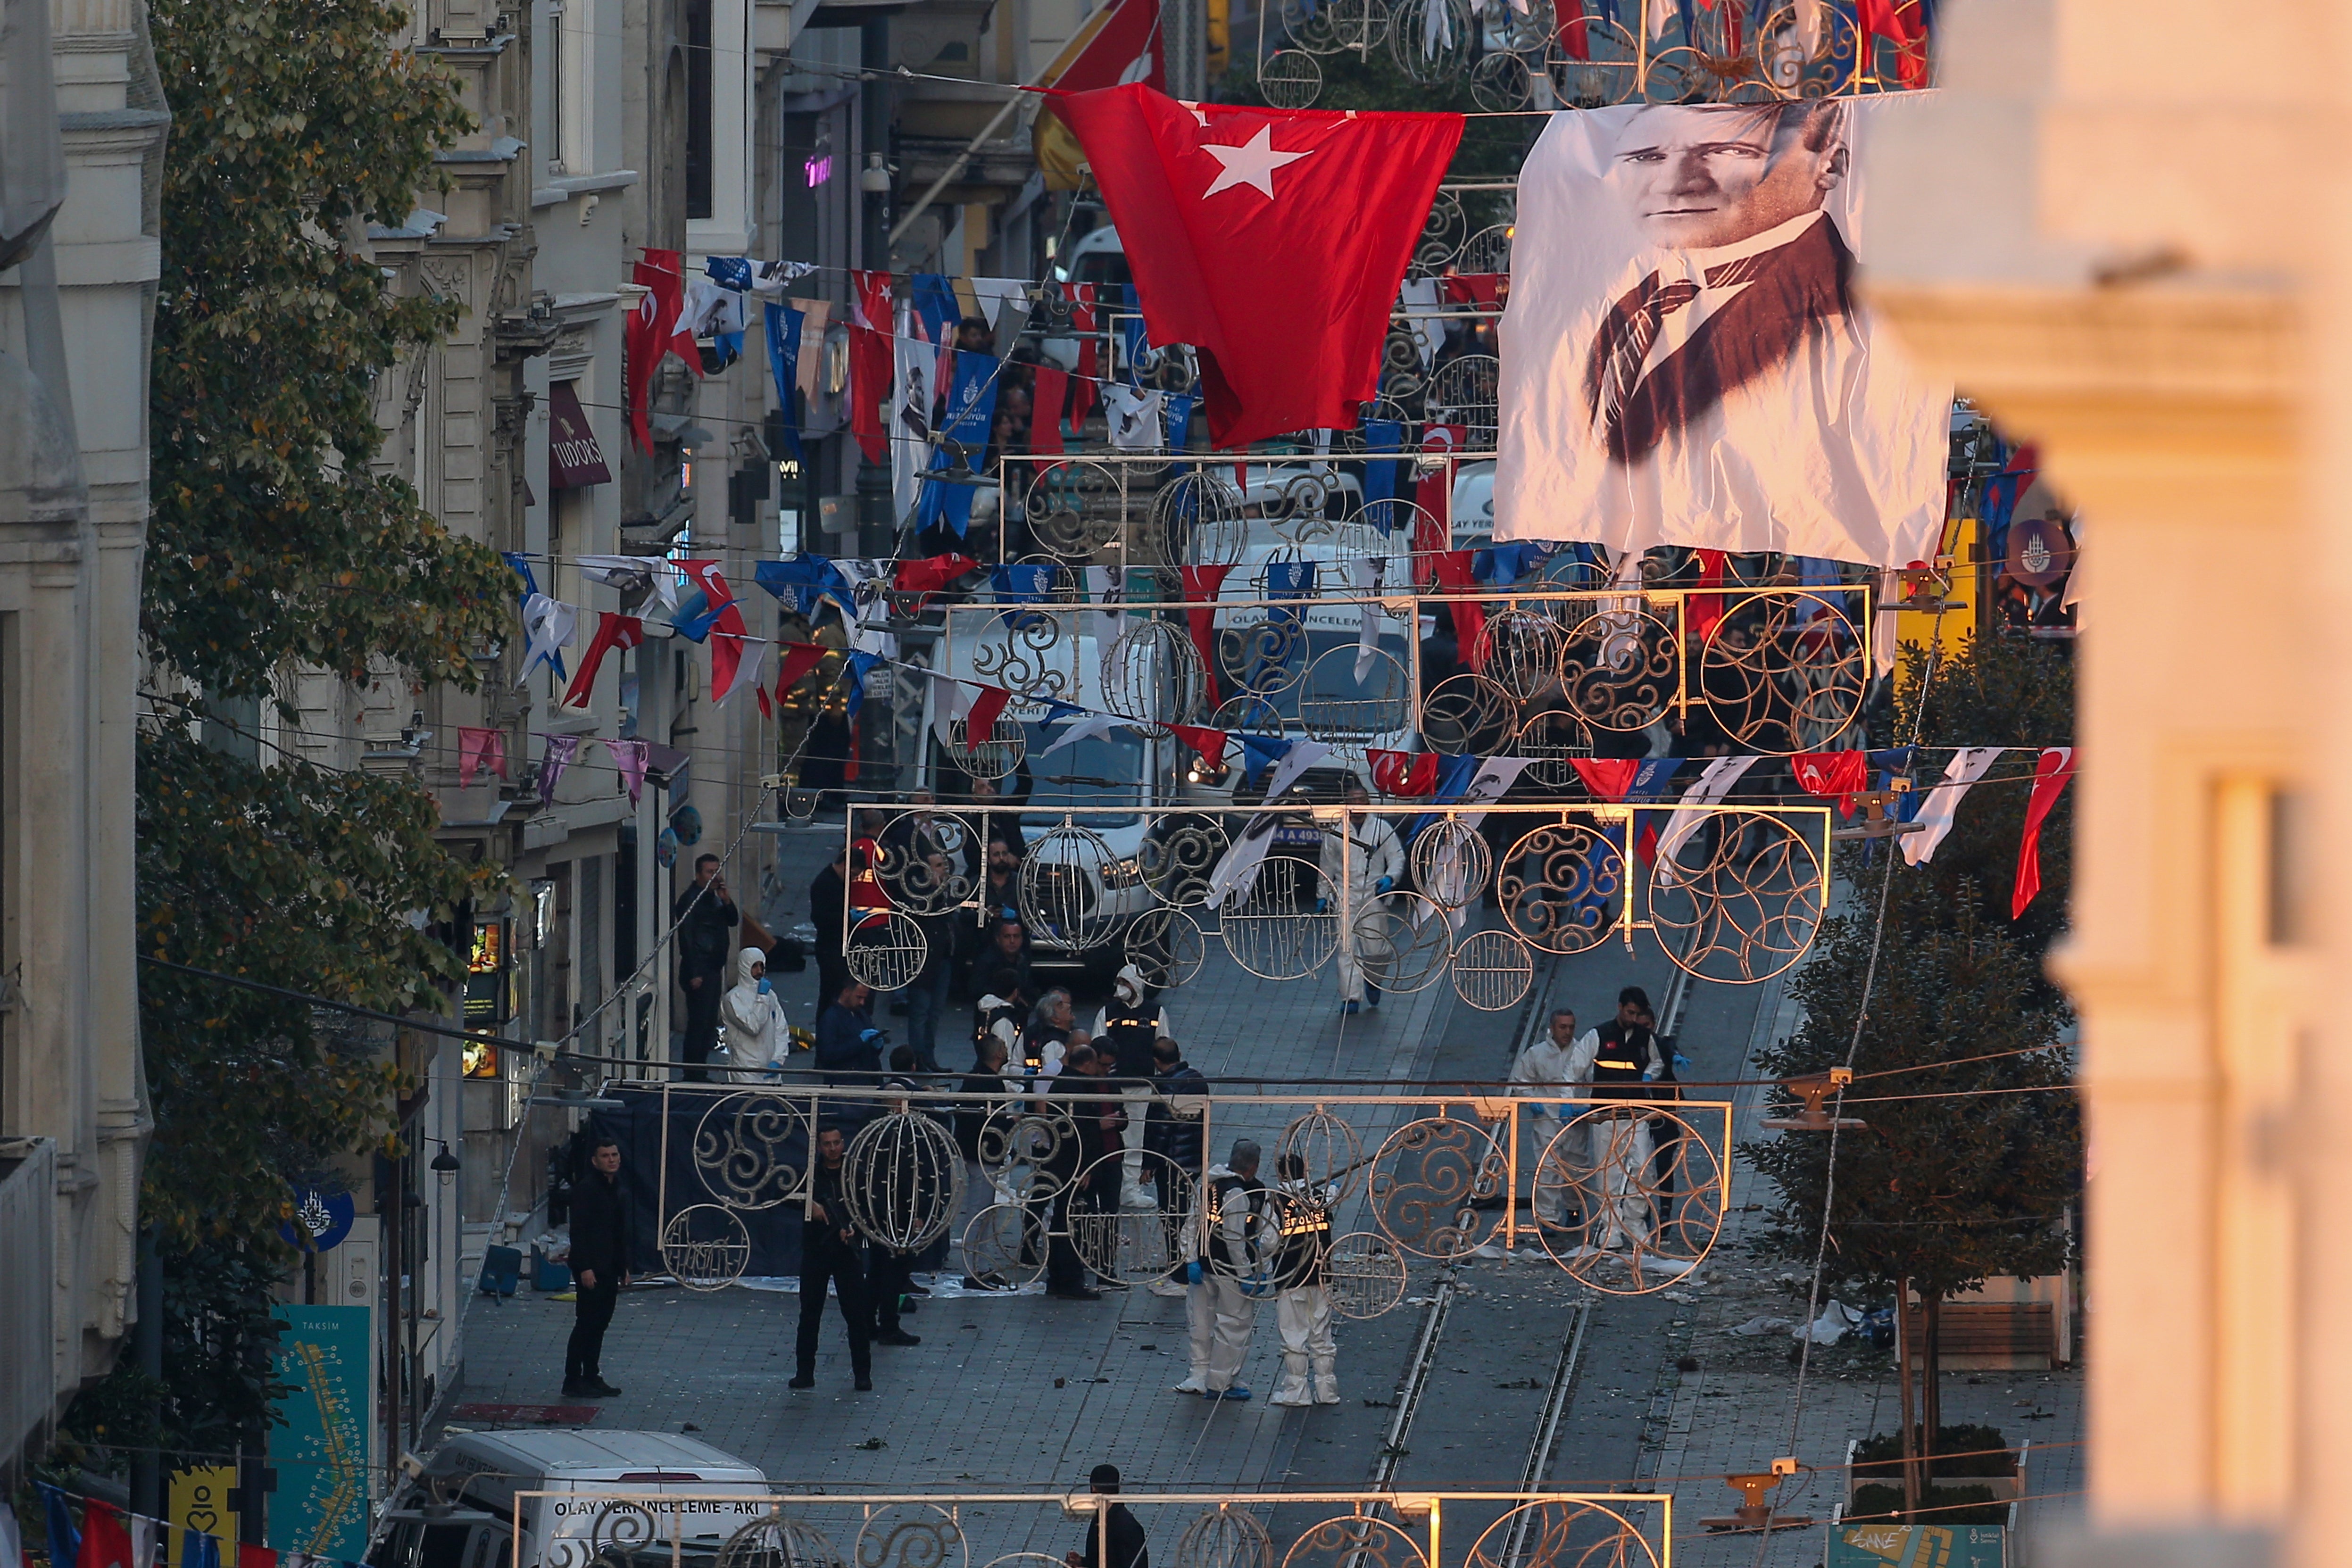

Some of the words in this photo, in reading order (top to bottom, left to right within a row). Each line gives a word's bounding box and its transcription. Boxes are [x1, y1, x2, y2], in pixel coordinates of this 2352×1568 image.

[552, 438, 602, 468] TUDORS
[1233, 615, 1268, 624] OLAY
[1288, 830, 1296, 839] A
[302, 1321, 339, 1330] TAKSİM
[555, 1502, 597, 1516] OLAY
